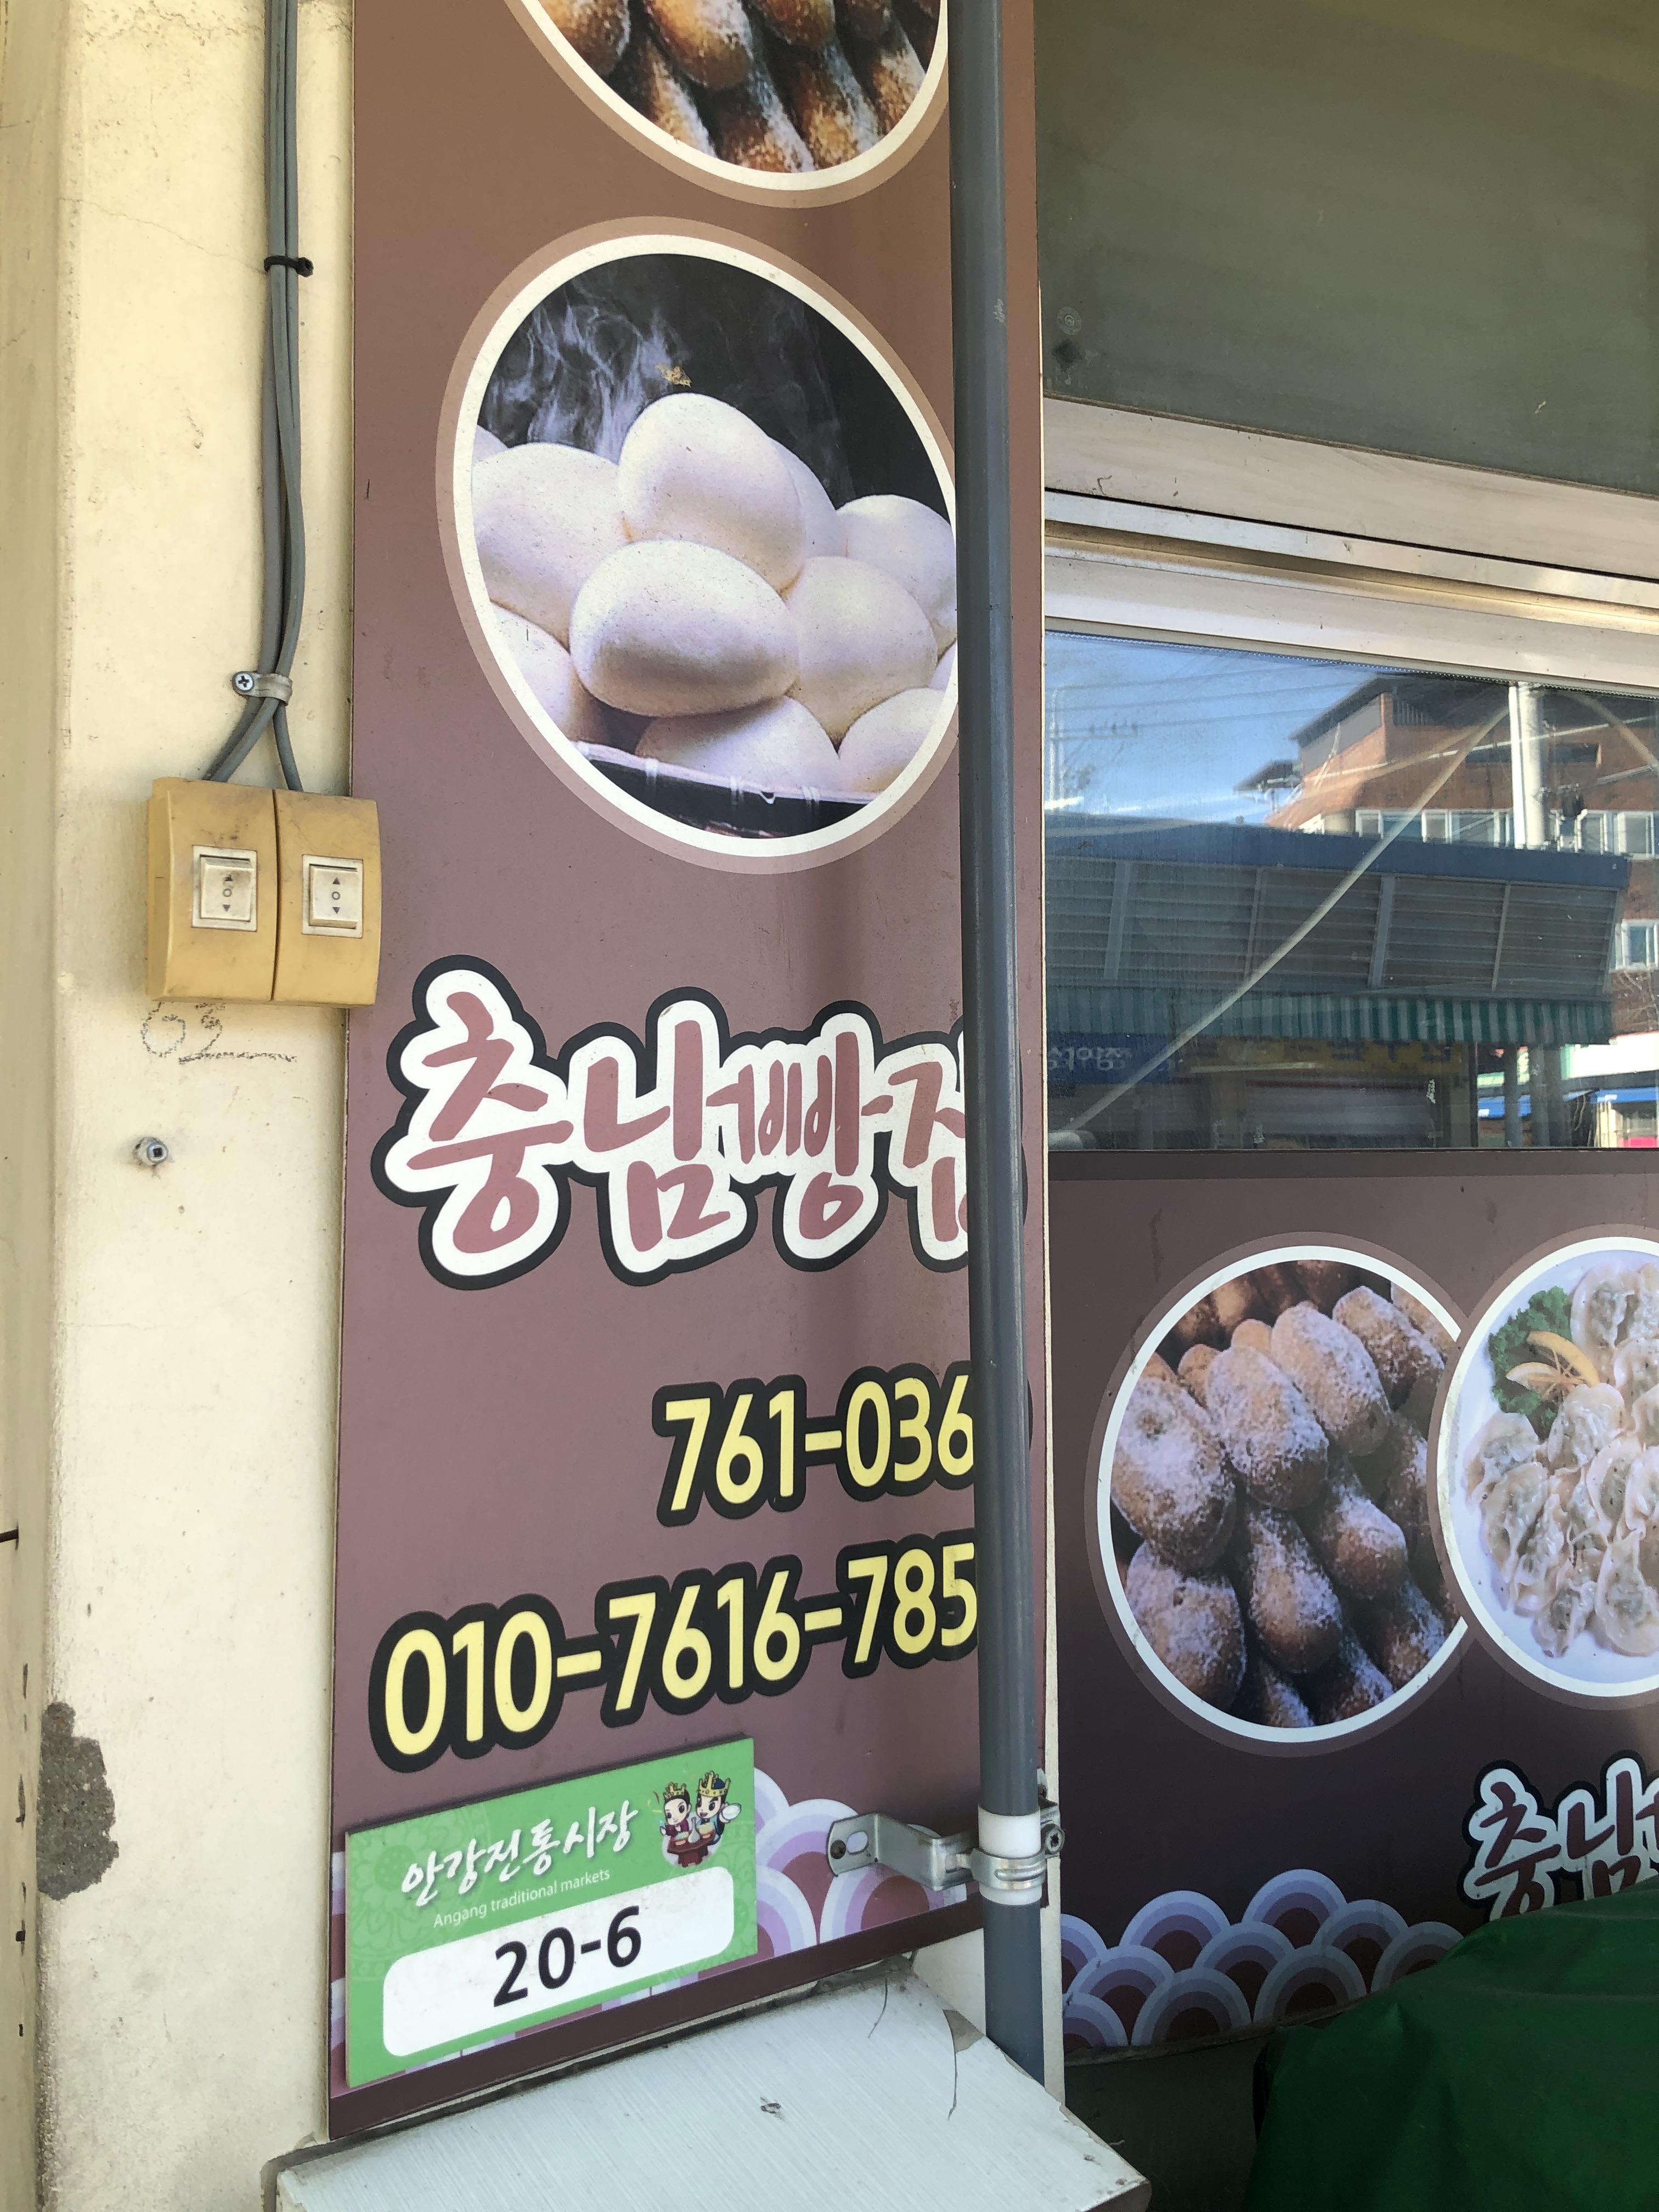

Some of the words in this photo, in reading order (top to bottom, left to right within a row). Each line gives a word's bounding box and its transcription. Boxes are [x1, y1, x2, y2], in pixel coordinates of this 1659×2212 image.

[664, 1373, 975, 1513] 761-036
[383, 1541, 979, 1757] 010-7616-785
[400, 1799, 639, 1908] 안강전통시장
[433, 1901, 487, 1929] Angang
[491, 1881, 557, 1912] traditional
[560, 1867, 611, 1893] markets
[1463, 1758, 1659, 1921] 충남
[493, 1905, 642, 2008] 20-6
